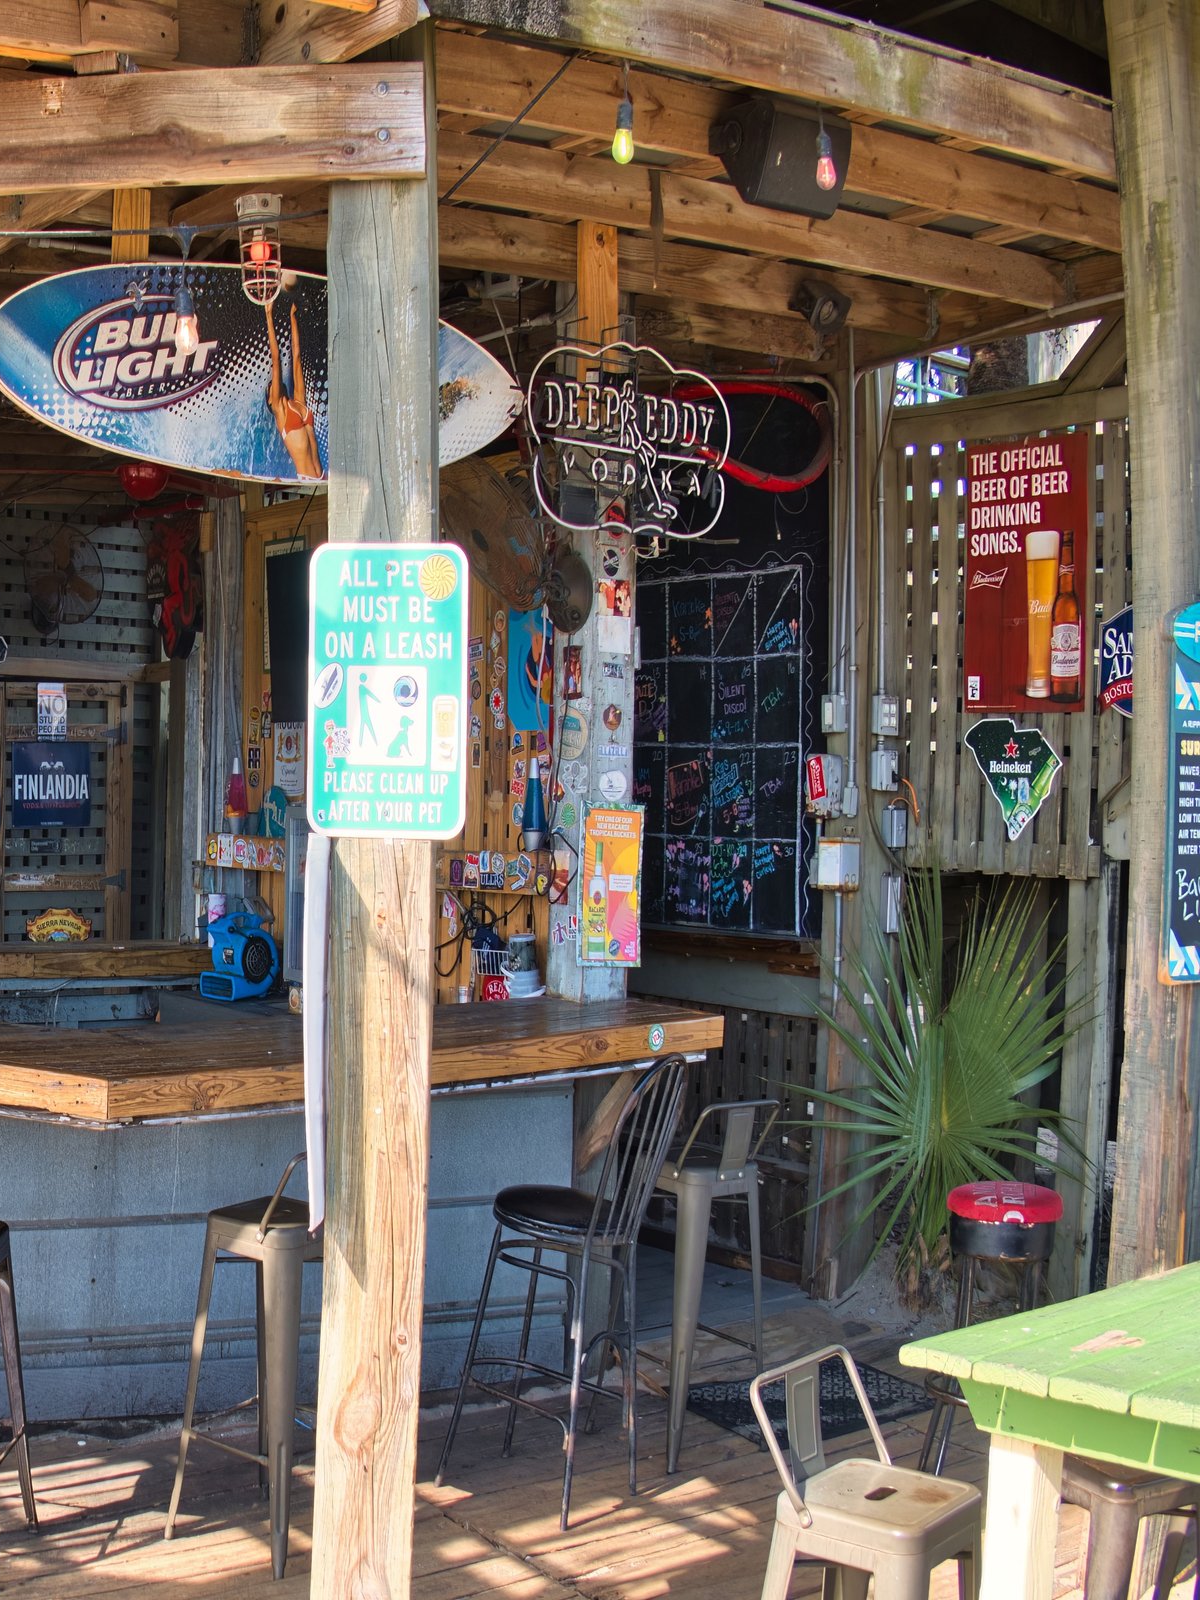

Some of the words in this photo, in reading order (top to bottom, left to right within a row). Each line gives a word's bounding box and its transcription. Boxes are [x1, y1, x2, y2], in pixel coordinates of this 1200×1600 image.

[76, 340, 218, 392] LIGHT
[126, 384, 166, 397] BEER
[545, 381, 620, 432] DEEP
[643, 395, 715, 450] EDDY
[971, 452, 997, 476] THE
[1001, 444, 1063, 473] OFFICIAL
[563, 451, 700, 496] VODKA
[971, 478, 1006, 503] BEER
[1010, 475, 1028, 499] OF
[1031, 470, 1068, 497] BEER
[971, 501, 1041, 530] DRINKING
[971, 530, 1022, 557] SONGS.
[339, 560, 378, 587] ALL
[973, 573, 1003, 585] Budweiser
[343, 596, 400, 623] MUST
[409, 597, 435, 623] BE
[325, 631, 354, 659] ON
[362, 632, 377, 659] A
[385, 632, 452, 660] LEASH
[1052, 655, 1079, 666] Budweiser
[39, 695, 66, 715] NO
[39, 715, 66, 724] STUPID
[39, 725, 66, 733] PEOPLE
[989, 761, 1033, 774] Heineken
[1180, 766, 1199, 776] WAVES
[15, 774, 89, 800] FINLANDIA
[323, 771, 374, 793] PLEASE
[380, 772, 424, 794] CLEAN
[430, 772, 448, 795] UP
[1180, 782, 1195, 792] WIND
[328, 800, 370, 822] AFTER
[376, 800, 413, 823] YOUR
[419, 802, 443, 823] PET
[1179, 797, 1195, 807] HIGH
[1179, 813, 1192, 823] LOW
[1178, 829, 1191, 839] AIR
[1178, 845, 1197, 855] WATER
[36, 920, 58, 932] SIERRA
[59, 919, 82, 932] NEVADA
